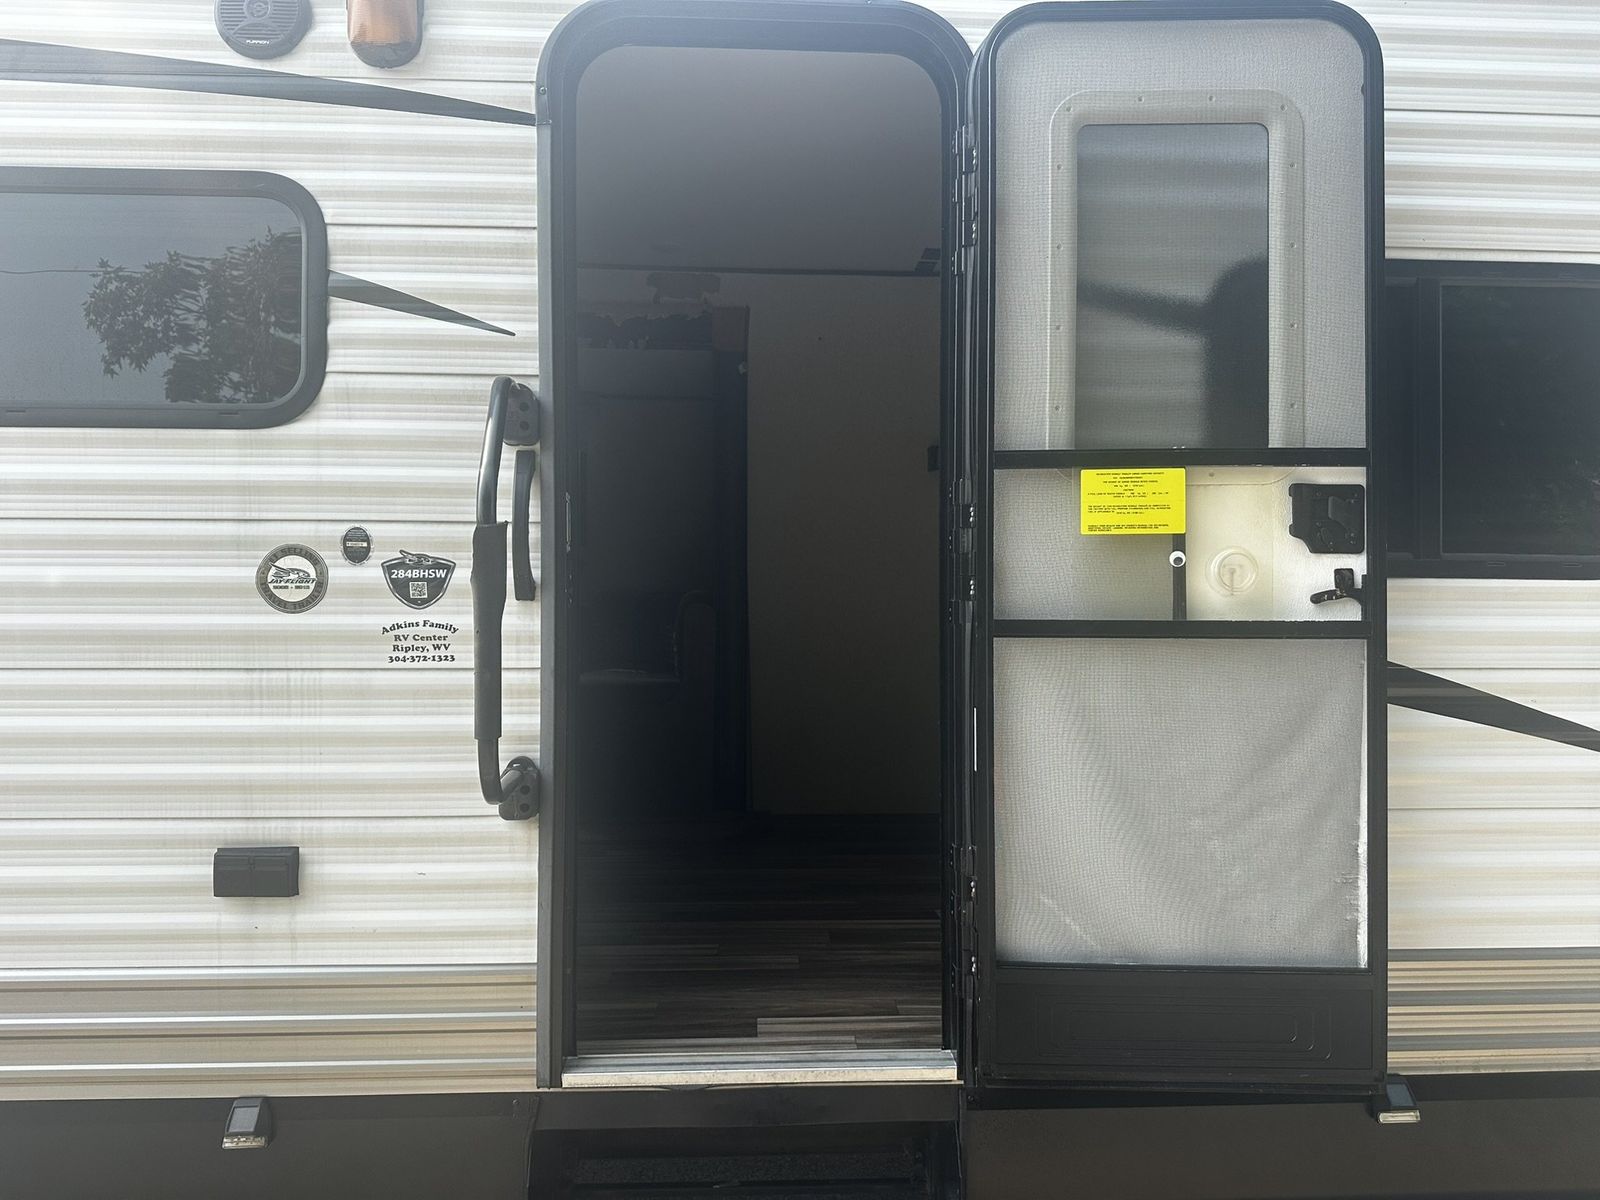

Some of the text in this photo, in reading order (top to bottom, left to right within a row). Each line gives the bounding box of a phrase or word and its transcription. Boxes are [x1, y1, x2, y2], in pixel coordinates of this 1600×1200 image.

[390, 569, 447, 579] 284BHSW
[382, 619, 459, 635] Adkins Family
[393, 633, 449, 642] RV Center
[392, 643, 451, 653] Ripley, WV
[387, 654, 456, 664] 304-372-1323
